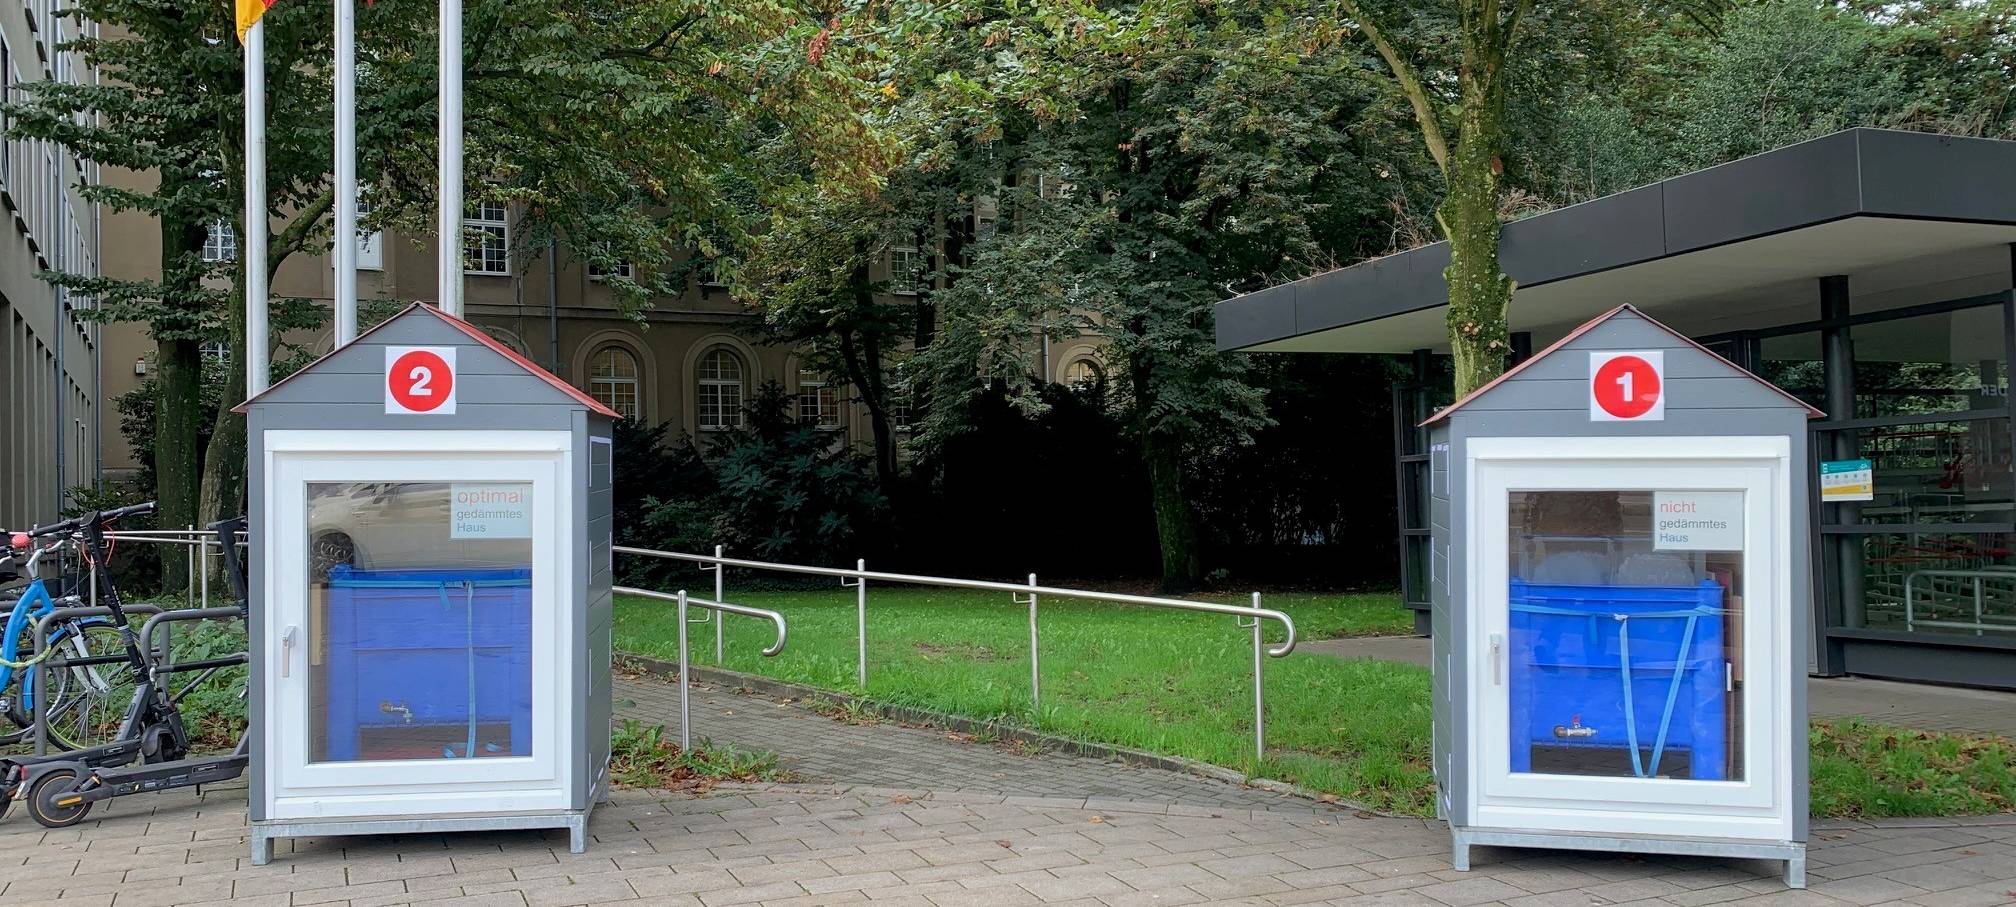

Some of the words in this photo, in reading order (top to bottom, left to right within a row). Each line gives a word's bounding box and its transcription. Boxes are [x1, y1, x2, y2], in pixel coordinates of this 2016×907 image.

[408, 366, 432, 396] 2
[1616, 371, 1633, 402] 1
[457, 487, 524, 506] optimal
[1660, 500, 1696, 513] nicht
[456, 508, 522, 521] gedämmtes
[457, 522, 486, 533] Haus
[1659, 518, 1727, 531] gedämmtes
[1659, 533, 1689, 543] Haus
